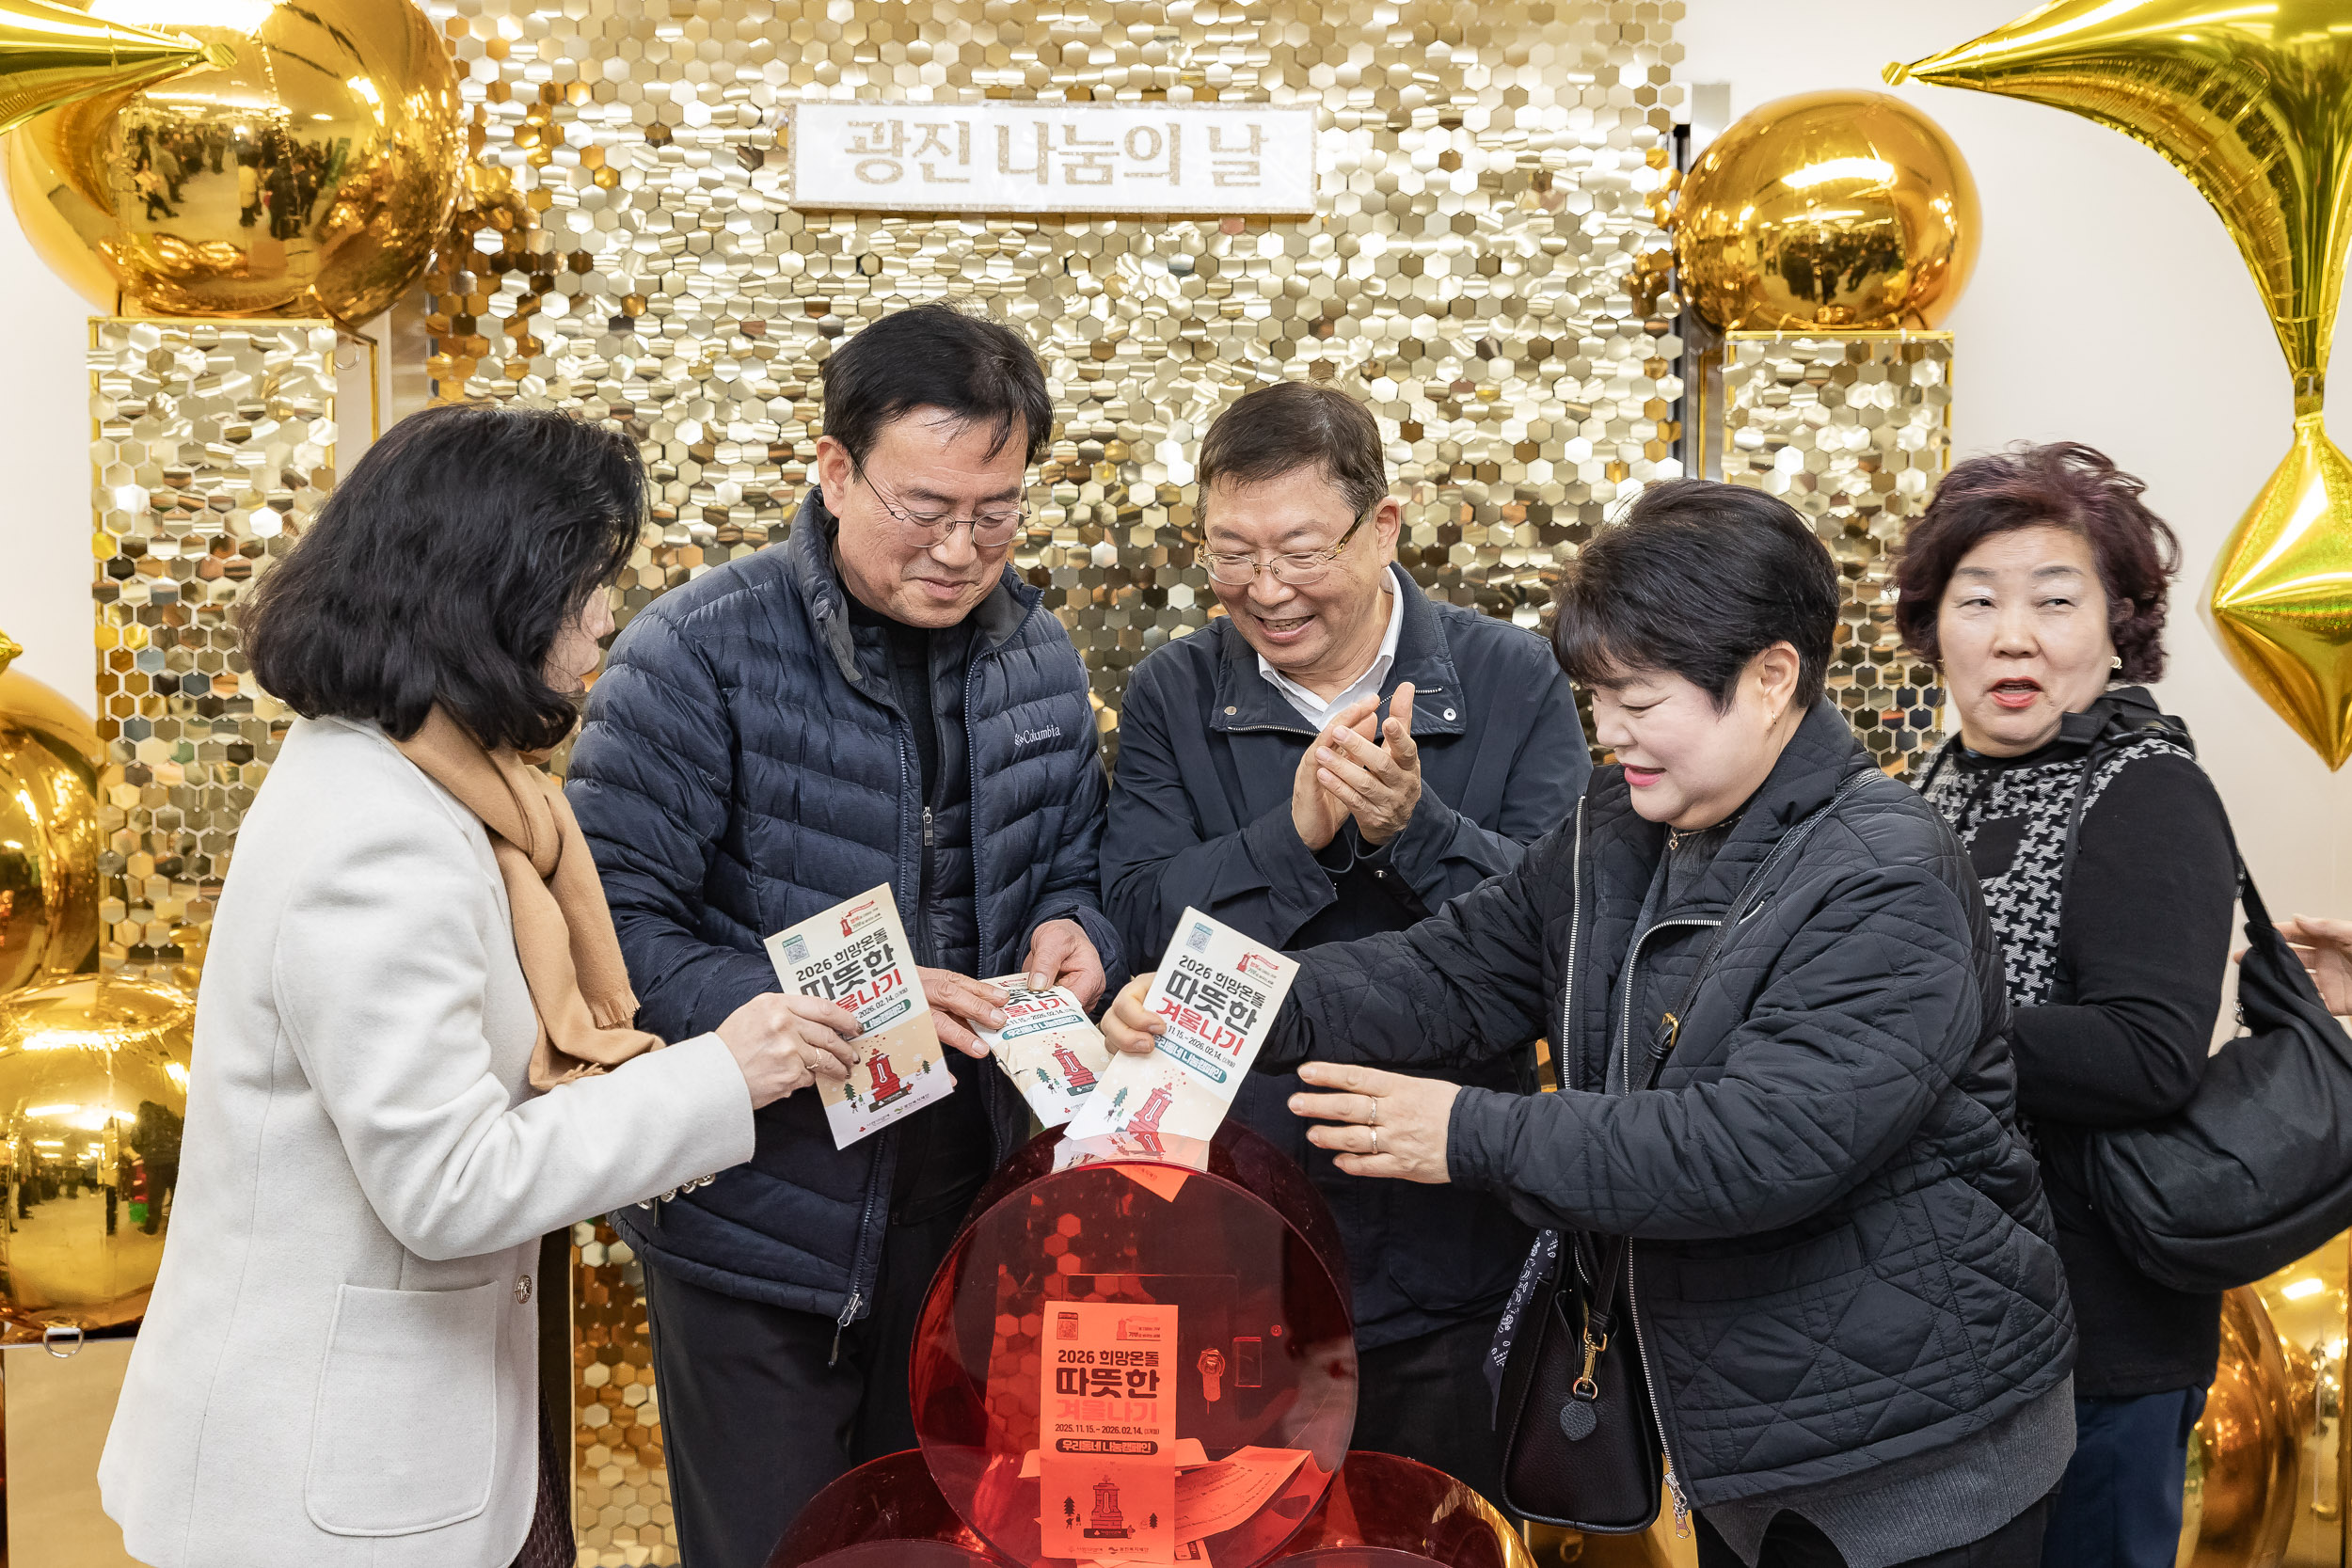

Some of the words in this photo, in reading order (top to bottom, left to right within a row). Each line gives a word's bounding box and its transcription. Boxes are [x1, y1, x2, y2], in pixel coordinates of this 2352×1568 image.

[845, 119, 970, 185] 광진
[994, 120, 1182, 186] 나눔의
[1207, 123, 1269, 187] 날
[1024, 724, 1060, 744] Columbia
[796, 958, 833, 981] 2026
[834, 927, 889, 965] 희망온돌
[801, 943, 897, 1001] 따뜻한
[1166, 970, 1257, 1036] 따뜻한
[1179, 955, 1213, 979] 2026
[1214, 972, 1266, 1009] 희망온돌
[1156, 997, 1245, 1056] 겨울나기
[1057, 1350, 1094, 1364] 2026
[1099, 1350, 1159, 1367] 희망온돌
[1057, 1367, 1160, 1399] 따뜻한
[1056, 1400, 1157, 1423] 겨울나기
[1062, 1440, 1102, 1451] 우리동네
[1103, 1441, 1152, 1453] 나눔캠페인
